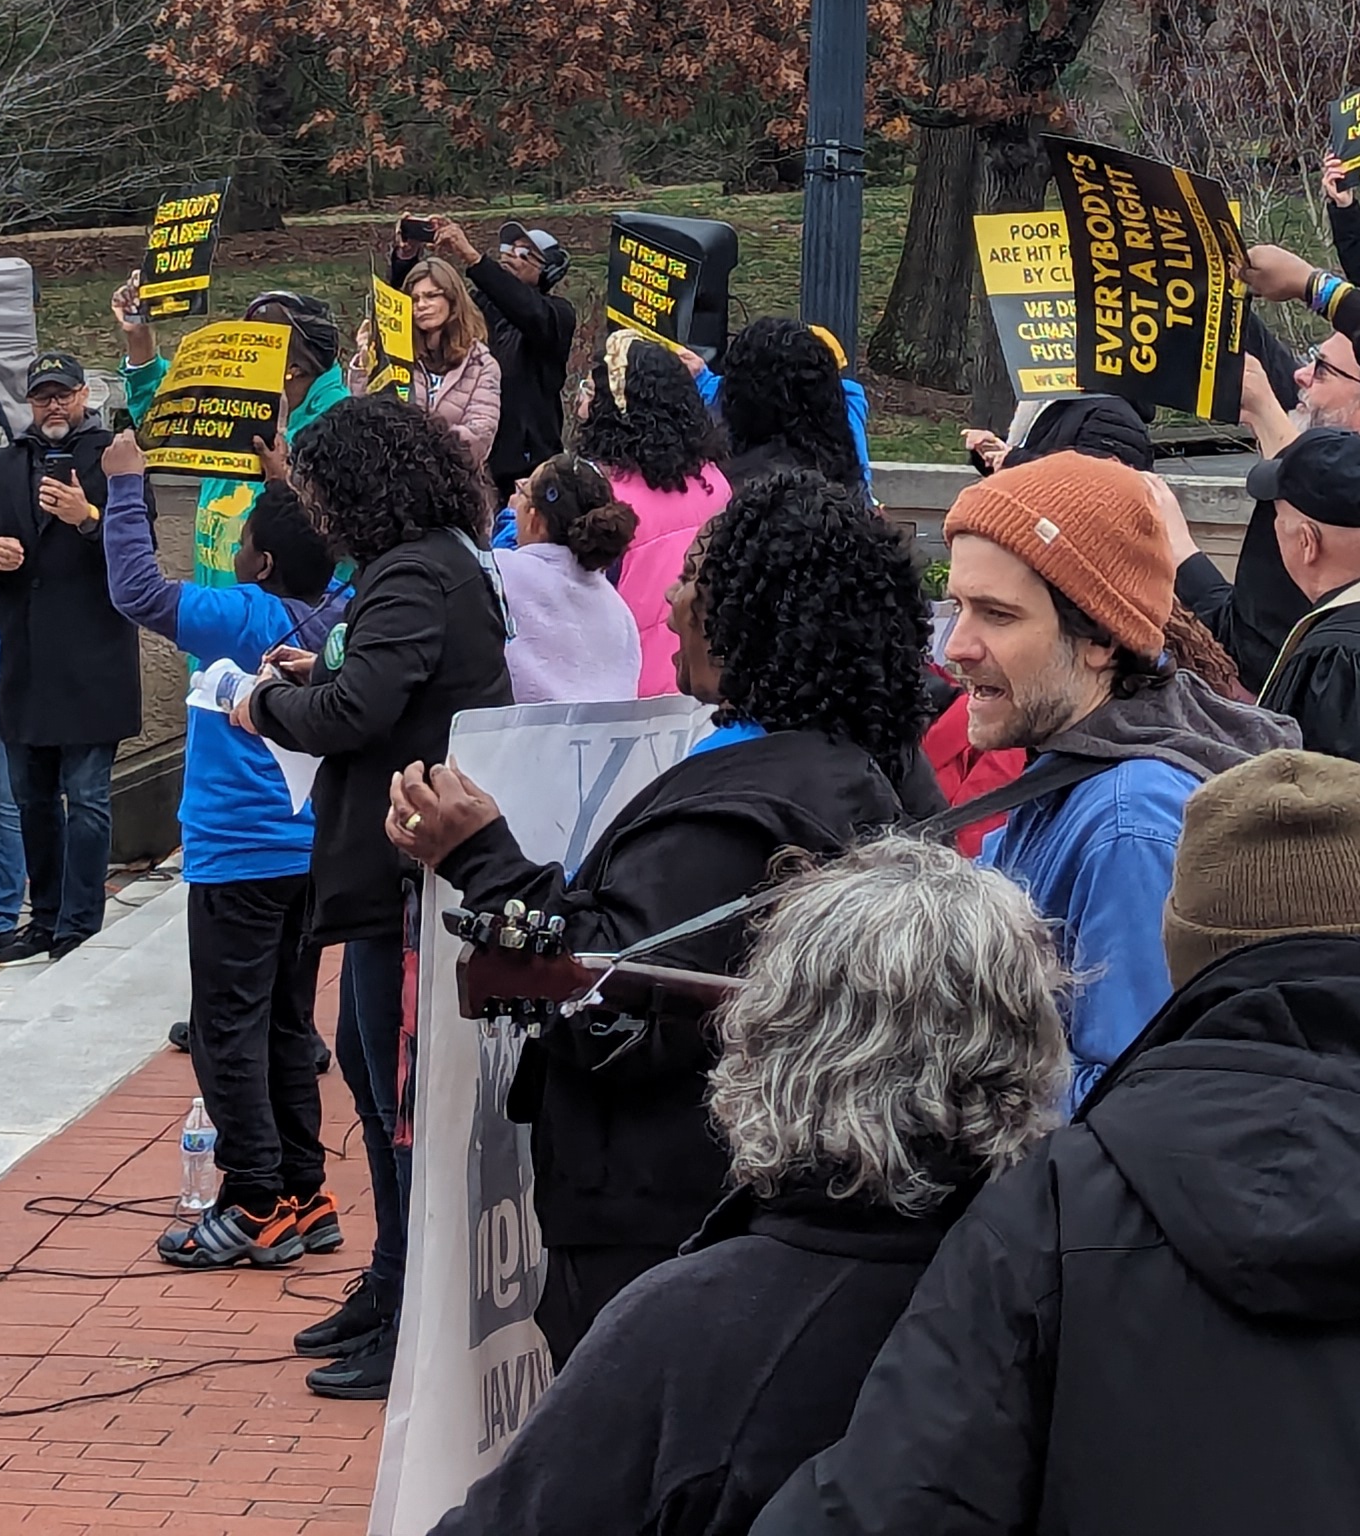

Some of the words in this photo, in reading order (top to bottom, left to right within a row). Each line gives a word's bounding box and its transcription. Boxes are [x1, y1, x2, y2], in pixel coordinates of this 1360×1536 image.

[1103, 164, 1157, 249] RIGHT
[1010, 223, 1061, 239] POOR
[1154, 205, 1195, 270] LIVE
[989, 246, 1021, 263] ARE
[1026, 244, 1053, 261] HIT
[1066, 151, 1123, 375] EVERYBODY'S
[1023, 267, 1045, 283] BY
[1128, 259, 1158, 286] A
[1024, 301, 1053, 318] WE
[1166, 278, 1196, 328] TO
[1018, 322, 1077, 340] CLIMAT
[1129, 291, 1160, 374] GOT
[1030, 344, 1075, 362] PUTS
[223, 365, 245, 378] U.S.
[197, 397, 272, 420] HOUSING
[171, 419, 188, 435] ALL
[192, 420, 234, 438] NOW
